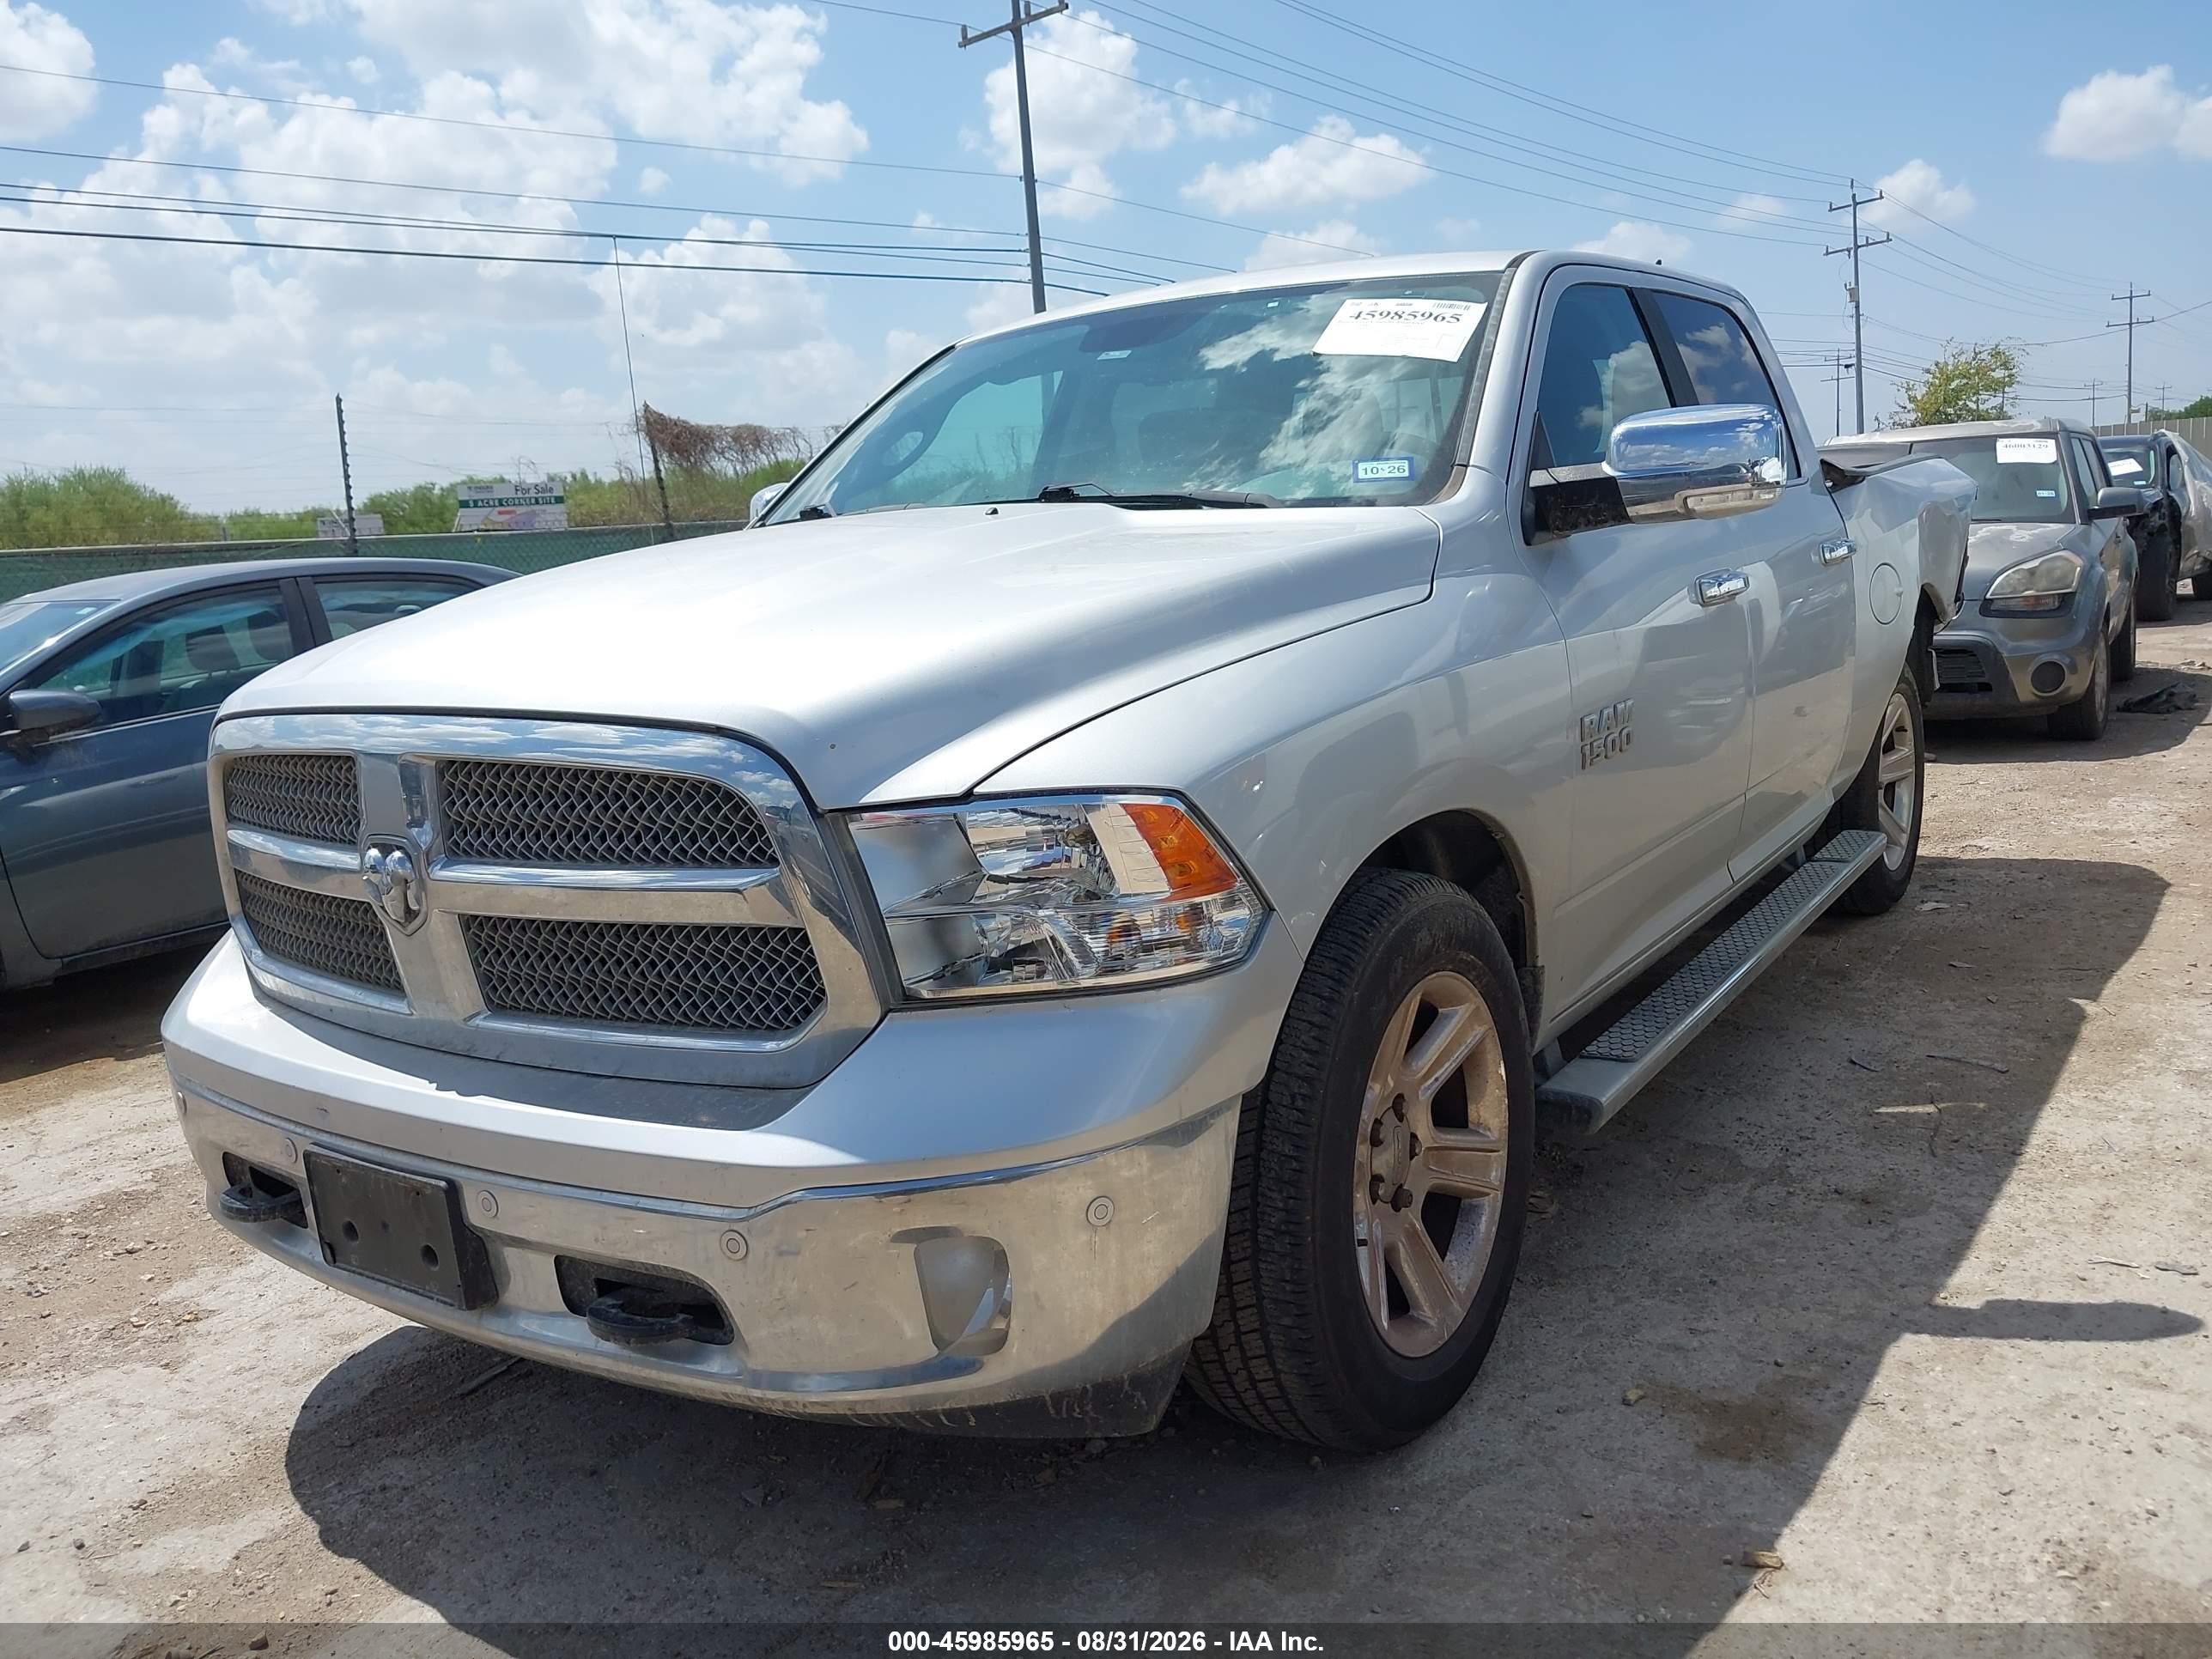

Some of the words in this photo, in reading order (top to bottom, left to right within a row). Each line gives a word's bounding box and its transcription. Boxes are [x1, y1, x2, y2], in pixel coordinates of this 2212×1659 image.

[1349, 309, 1464, 324] 45985965
[514, 485, 531, 495] For
[534, 483, 554, 495] Sale
[477, 498, 499, 507] ACRE
[502, 497, 536, 506] CORNER
[1580, 698, 1634, 743] RAM
[1580, 726, 1632, 770] 1500
